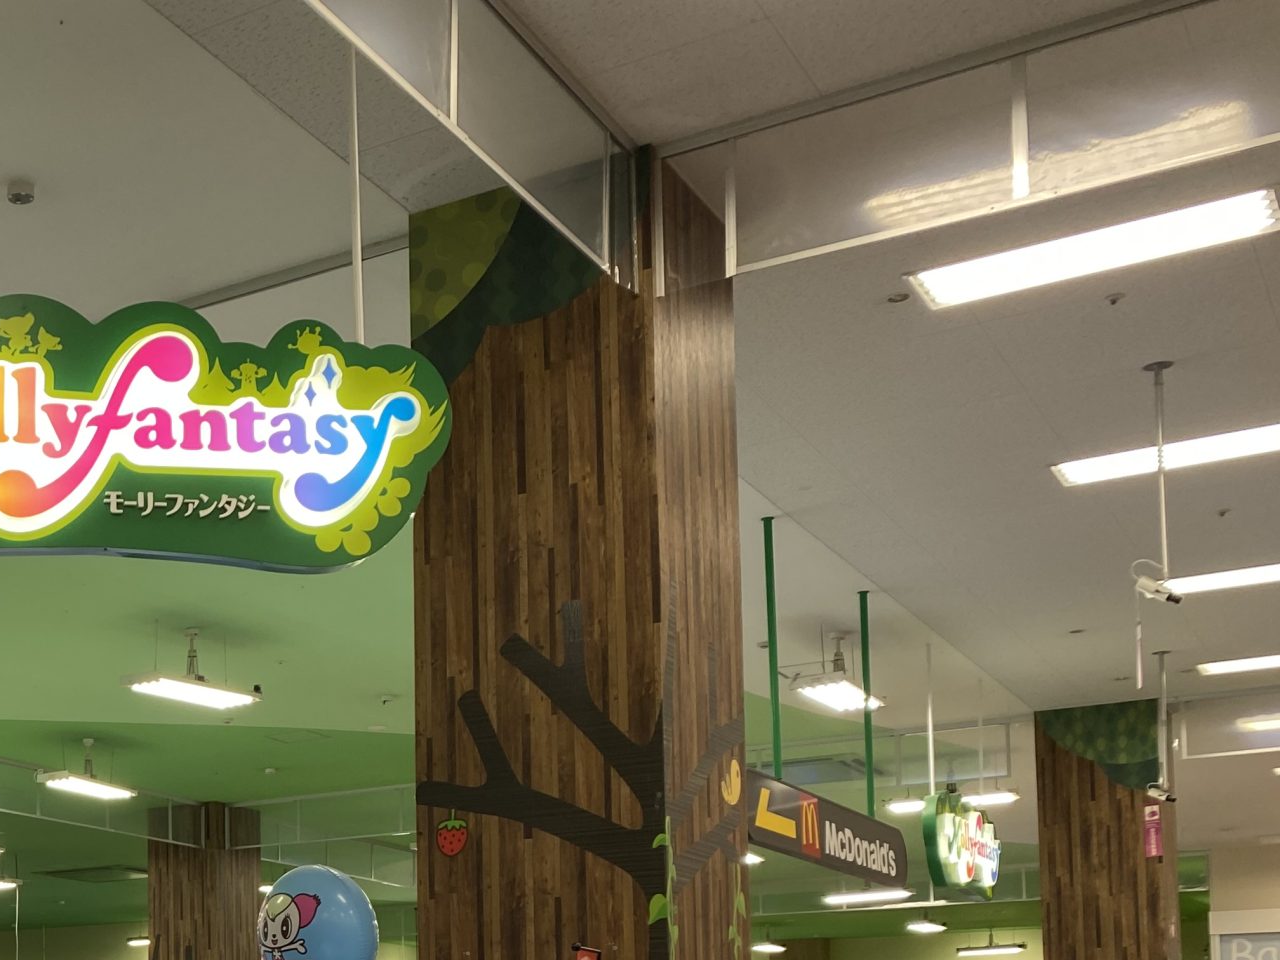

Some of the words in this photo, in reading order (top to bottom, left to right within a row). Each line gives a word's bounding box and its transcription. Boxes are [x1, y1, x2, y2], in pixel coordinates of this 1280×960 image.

[104, 491, 271, 519] モーリーファンタジー
[825, 820, 897, 877] McDonald's
